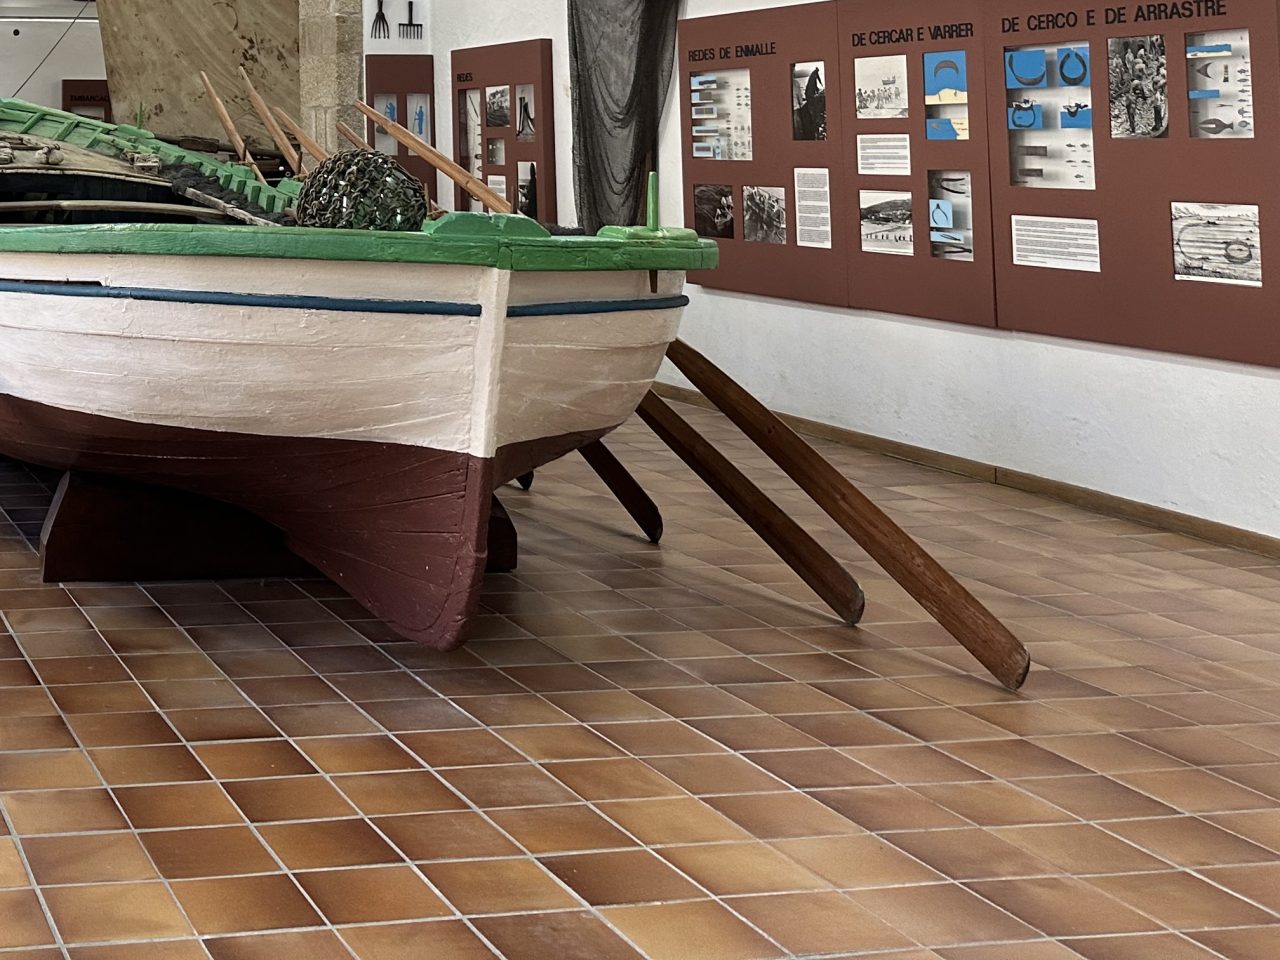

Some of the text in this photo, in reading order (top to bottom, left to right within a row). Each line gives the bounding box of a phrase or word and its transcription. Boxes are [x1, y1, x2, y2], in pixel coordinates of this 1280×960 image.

[1002, 16, 1020, 33] DE
[1027, 11, 1078, 30] CERCO
[1086, 9, 1096, 26] E
[1105, 6, 1126, 25] DE
[852, 22, 974, 47] DE CERCAR E VARRER
[688, 42, 776, 62] REDES DE ENMALLE
[457, 72, 473, 82] REDES
